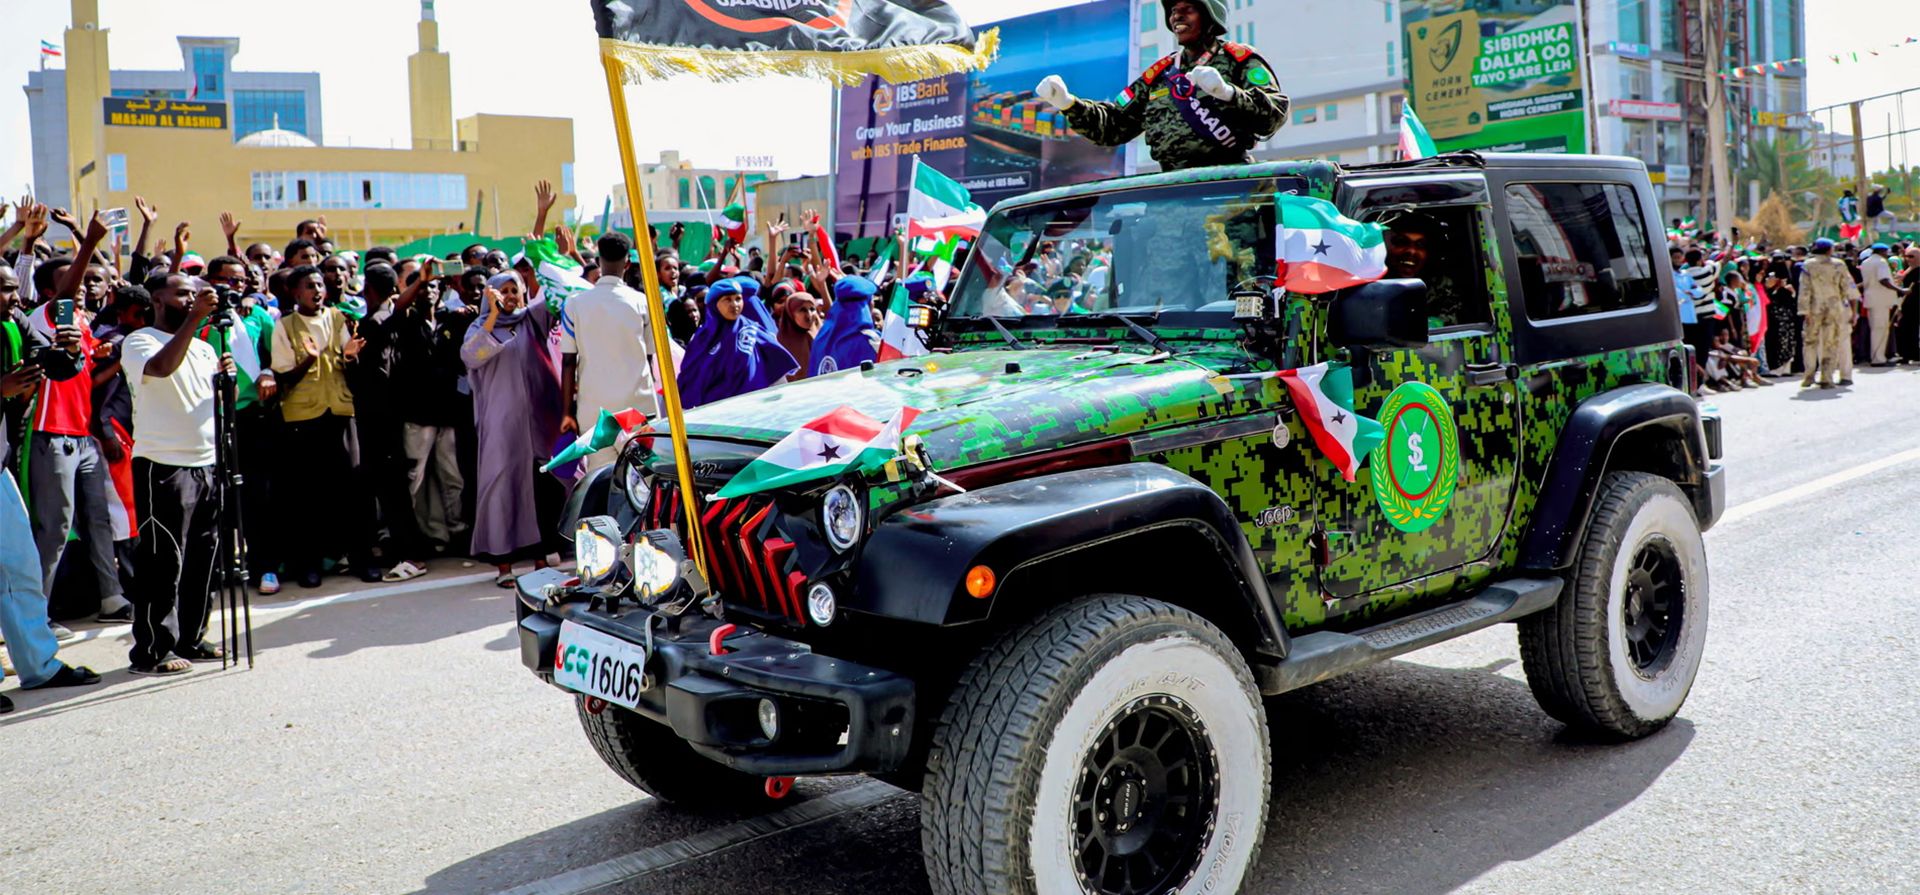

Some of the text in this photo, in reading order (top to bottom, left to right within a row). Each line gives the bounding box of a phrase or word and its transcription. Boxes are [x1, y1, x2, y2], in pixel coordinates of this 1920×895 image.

[1484, 26, 1569, 55] SIBIDHKA
[1480, 42, 1570, 72] DALKA OO
[1432, 75, 1462, 88] HORN
[1472, 59, 1572, 86] TAYO SARE LEH
[896, 79, 949, 102] IBSBank
[1425, 86, 1471, 102] CEMENT
[170, 102, 207, 113] مسجد
[1500, 102, 1563, 118] HORN CEMENT
[111, 112, 222, 129] MASJID AL RASHIID
[855, 114, 964, 140] Grow Your Business
[851, 136, 968, 160] with IBS Trade Finance.
[1255, 505, 1293, 528] Jeep
